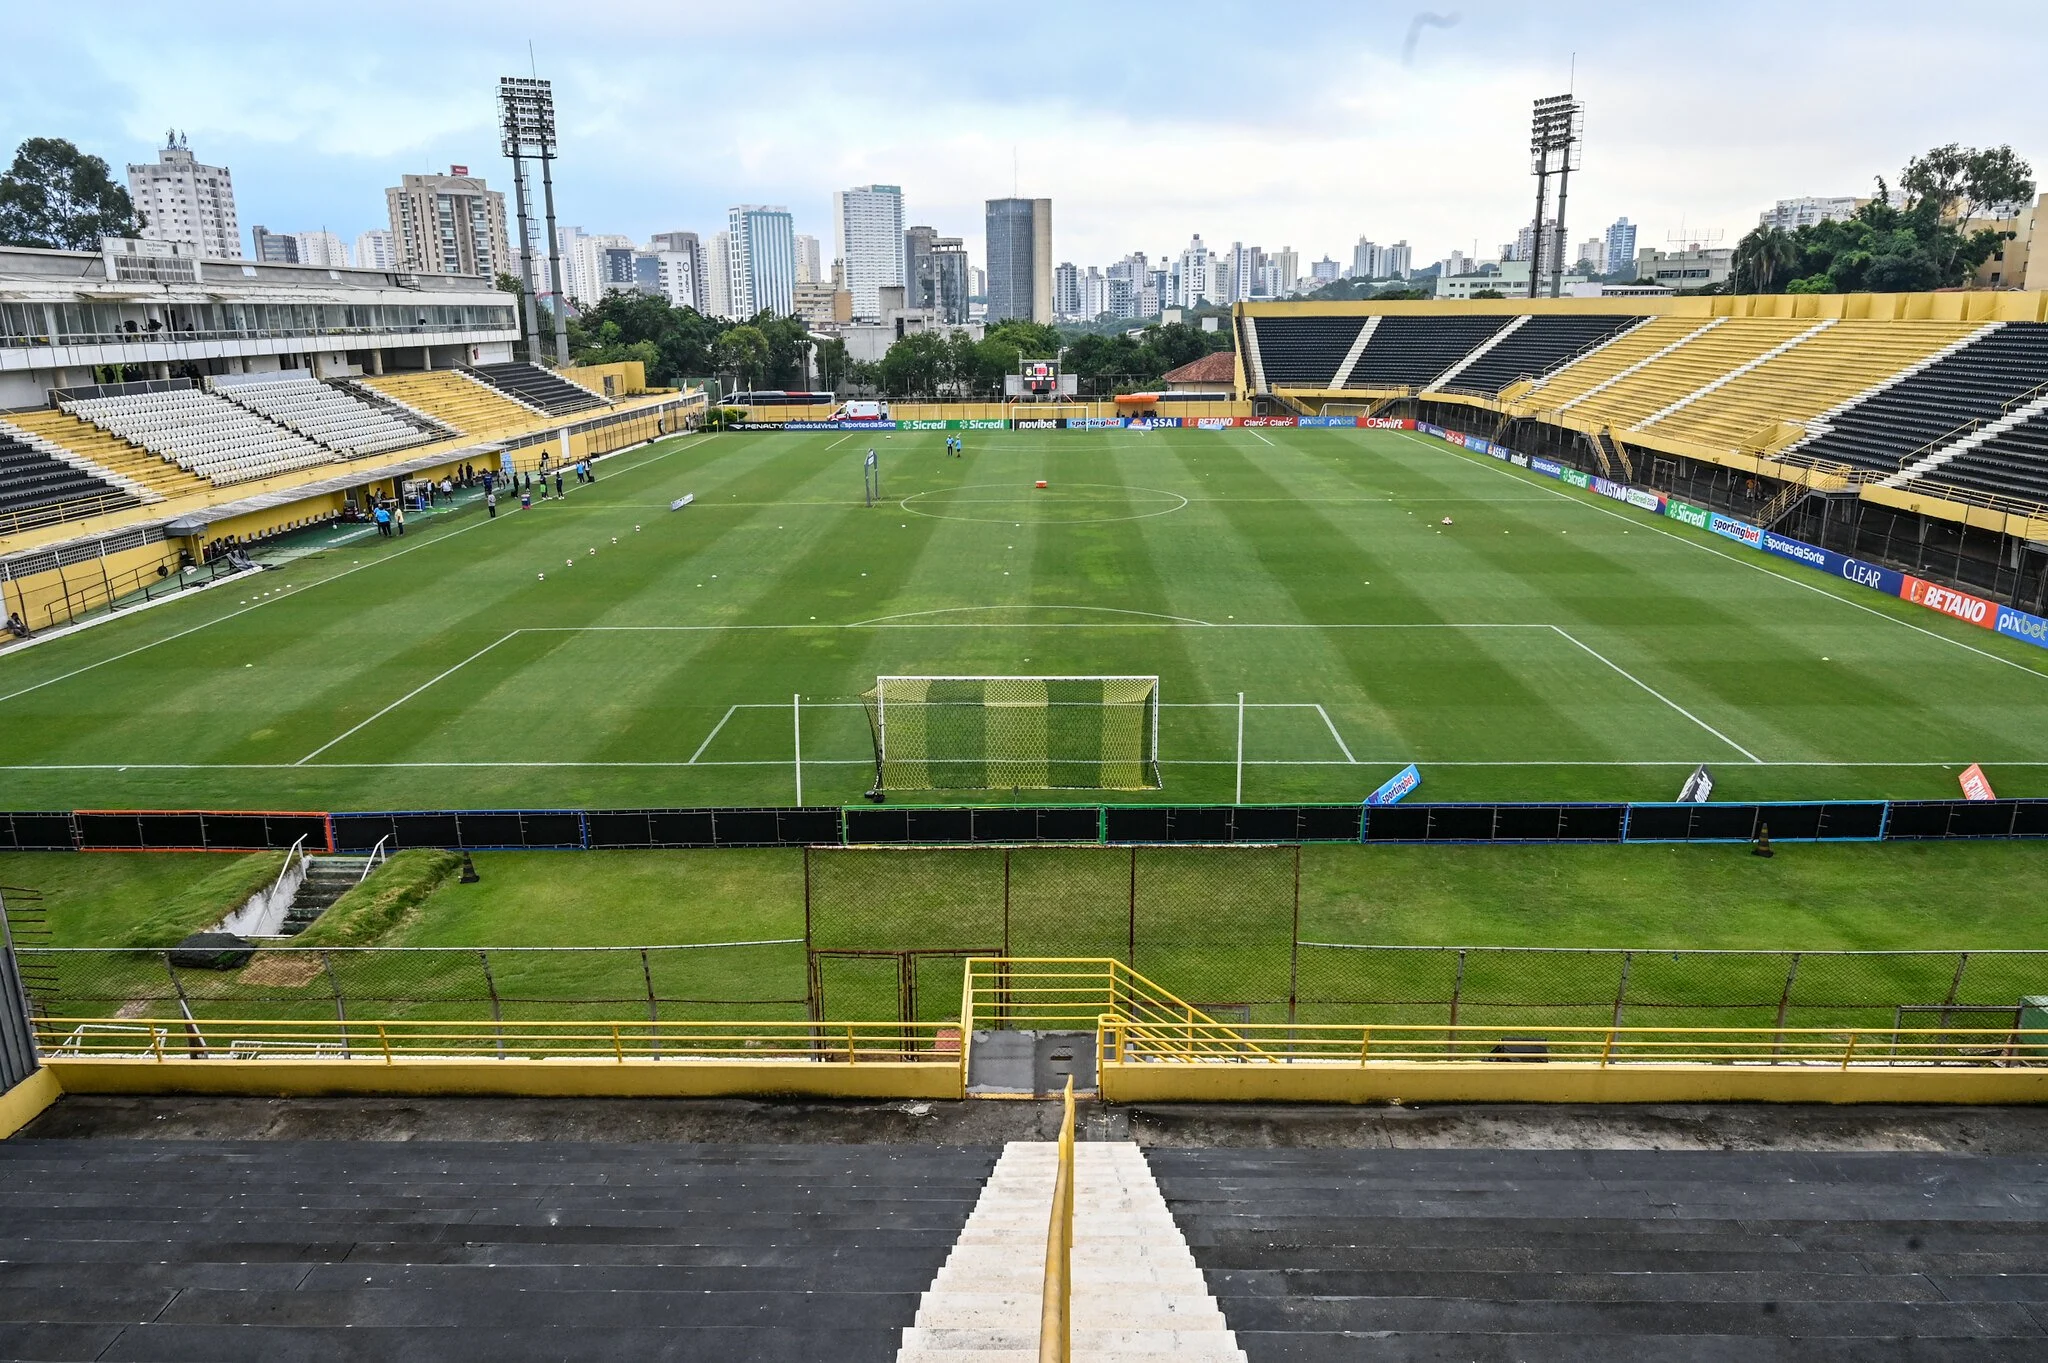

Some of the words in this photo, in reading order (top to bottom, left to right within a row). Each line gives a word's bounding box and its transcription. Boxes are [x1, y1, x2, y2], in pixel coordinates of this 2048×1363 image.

[840, 421, 869, 429] Esportes
[912, 420, 946, 429] Sicredi
[969, 420, 1003, 429] Sicredi
[1019, 420, 1057, 429] novibet
[1071, 419, 1120, 428] sportingbet
[1197, 417, 1233, 427] BETANO
[1299, 418, 1325, 427] pixbet
[1329, 418, 1355, 427] pixbet
[1376, 418, 1403, 429] Swift
[1510, 453, 1528, 468] novibet
[1567, 470, 1587, 488] Sicredi
[1677, 505, 1706, 527] Sicredi
[1713, 518, 1760, 544] sportingbet
[1763, 535, 1795, 555] Esportes
[1794, 545, 1803, 558] da
[1803, 548, 1825, 565] Sorte
[1843, 559, 1881, 589] CLEAR
[1924, 586, 1986, 622] BETANO
[1998, 612, 2048, 640] pixbet
[1381, 773, 1415, 803] sportingbet
